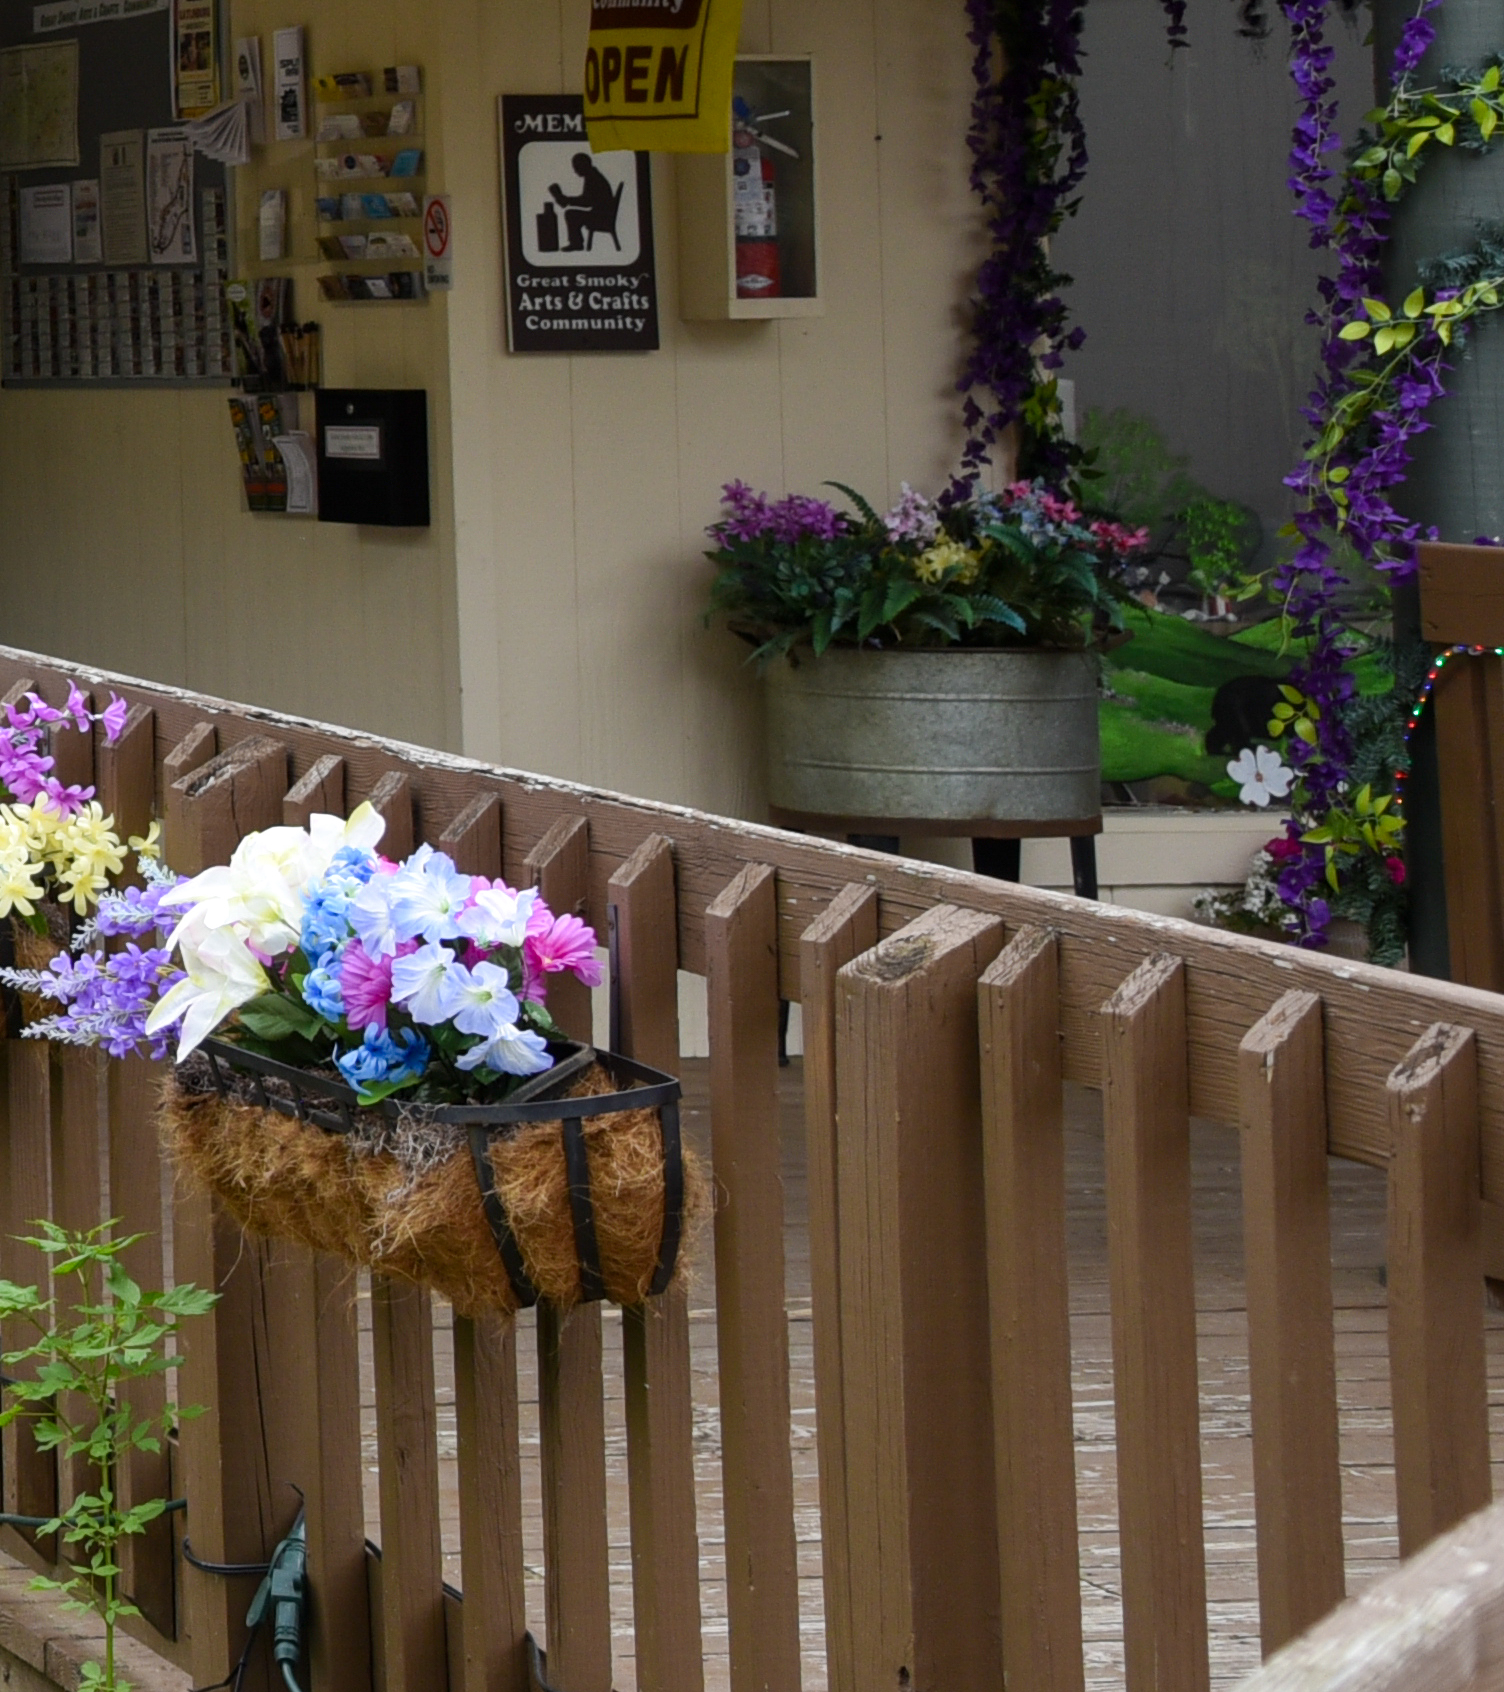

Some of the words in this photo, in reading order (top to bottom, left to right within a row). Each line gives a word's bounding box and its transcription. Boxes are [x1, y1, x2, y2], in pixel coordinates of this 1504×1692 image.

[585, 44, 689, 105] OPEN
[514, 113, 583, 134] MEM
[516, 274, 570, 288] Great
[575, 273, 651, 290] Smoky
[518, 292, 563, 311] Arts
[567, 291, 583, 310] &
[588, 291, 650, 311] Crafts
[525, 315, 646, 333] Community
